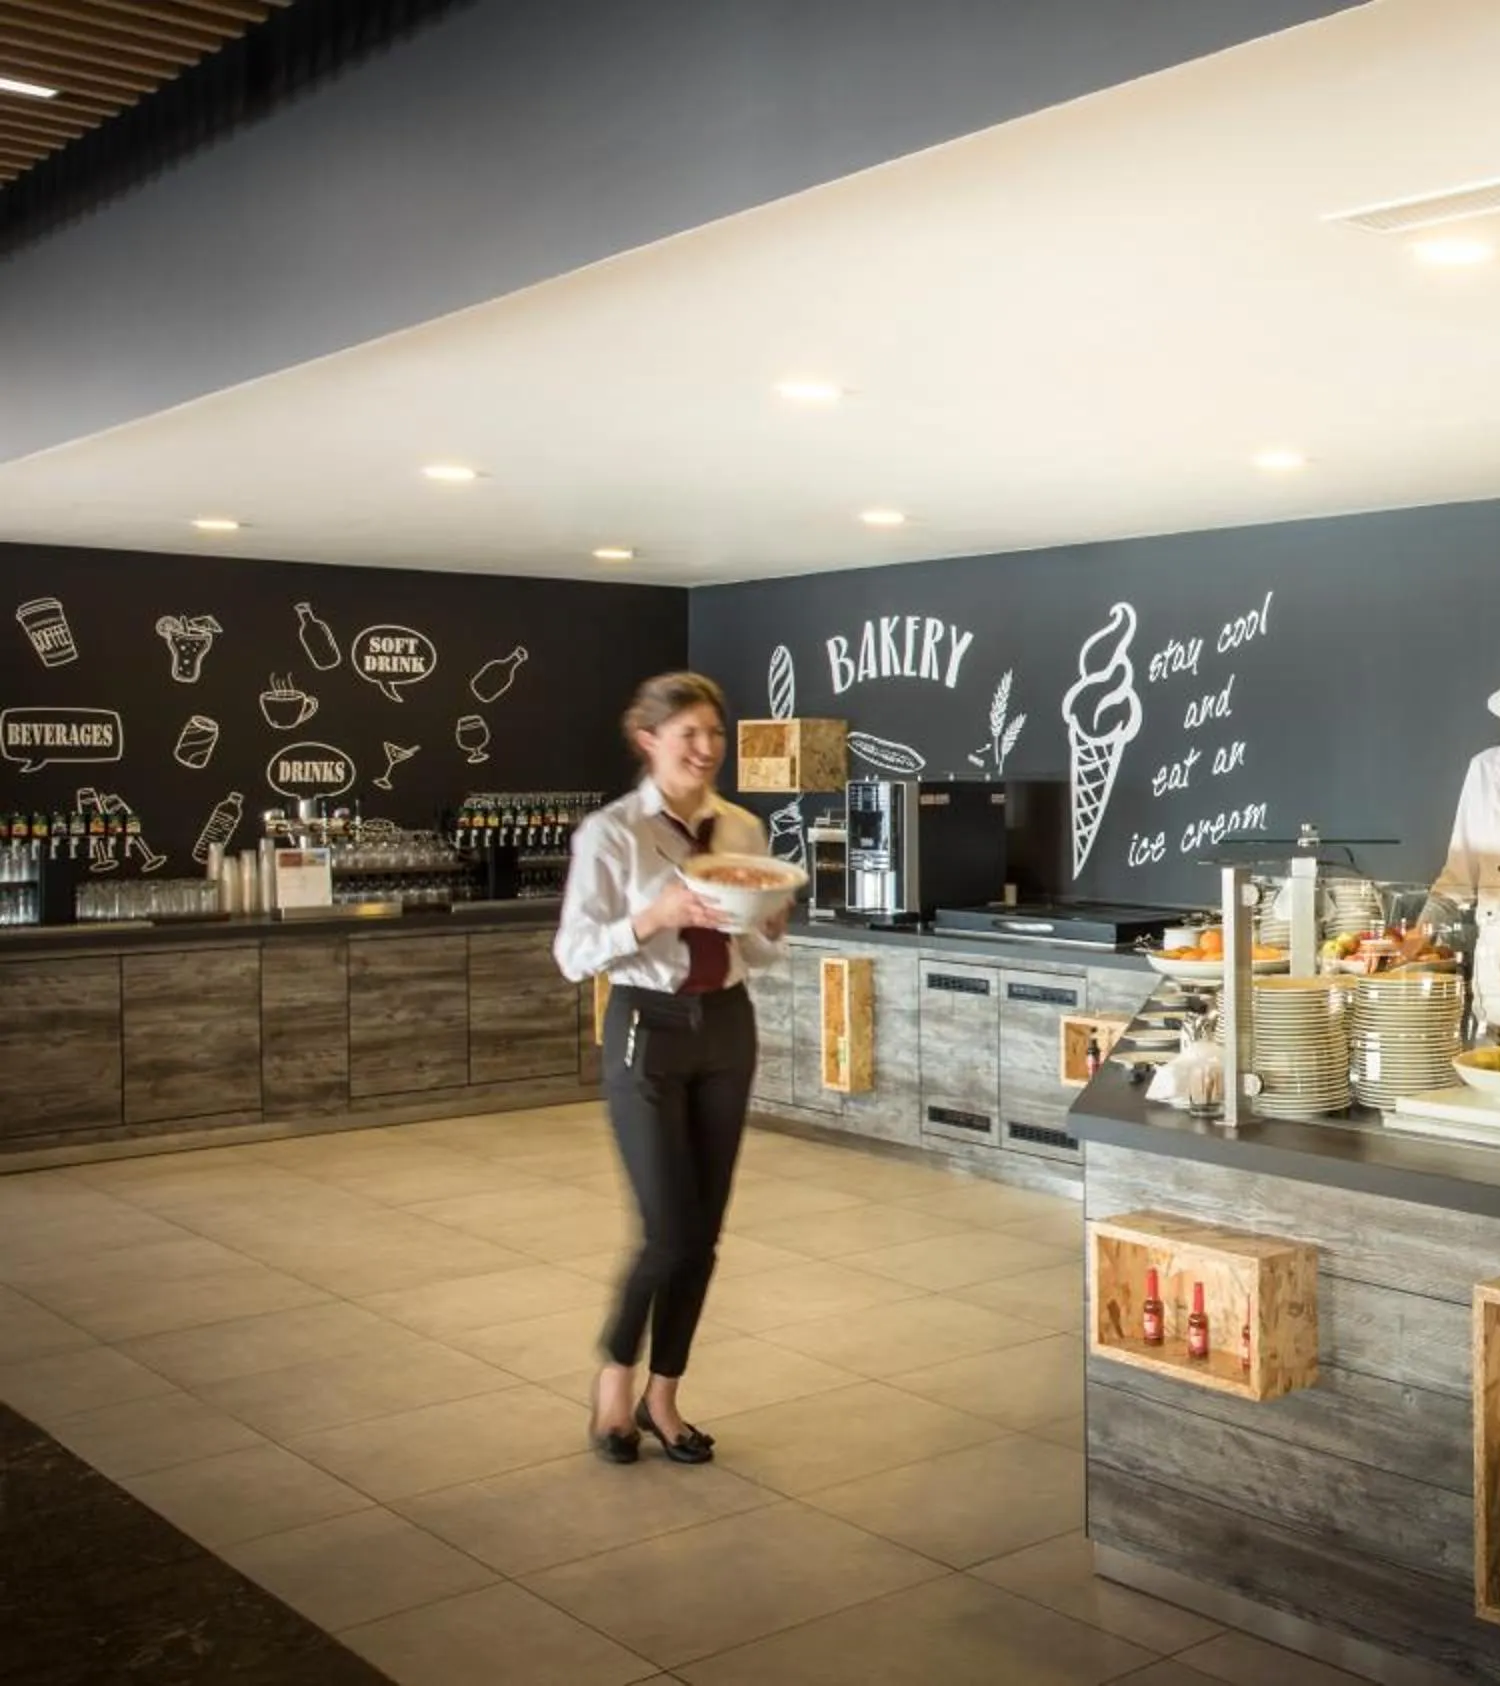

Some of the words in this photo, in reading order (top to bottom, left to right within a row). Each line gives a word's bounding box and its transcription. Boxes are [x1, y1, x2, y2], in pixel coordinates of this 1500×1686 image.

[31, 623, 72, 653] COFFEE
[369, 636, 419, 655] SOFT
[825, 614, 975, 695] BAKERY
[1149, 637, 1204, 682] stay
[1217, 590, 1274, 653] cool
[364, 655, 426, 673] DRINK
[1183, 672, 1236, 729] and
[7, 723, 113, 747] BEVERAGES
[278, 760, 346, 783] DRINKS
[1152, 747, 1201, 797] eat
[1212, 741, 1247, 776] an
[1128, 832, 1167, 868] ice
[1180, 802, 1268, 853] cream
